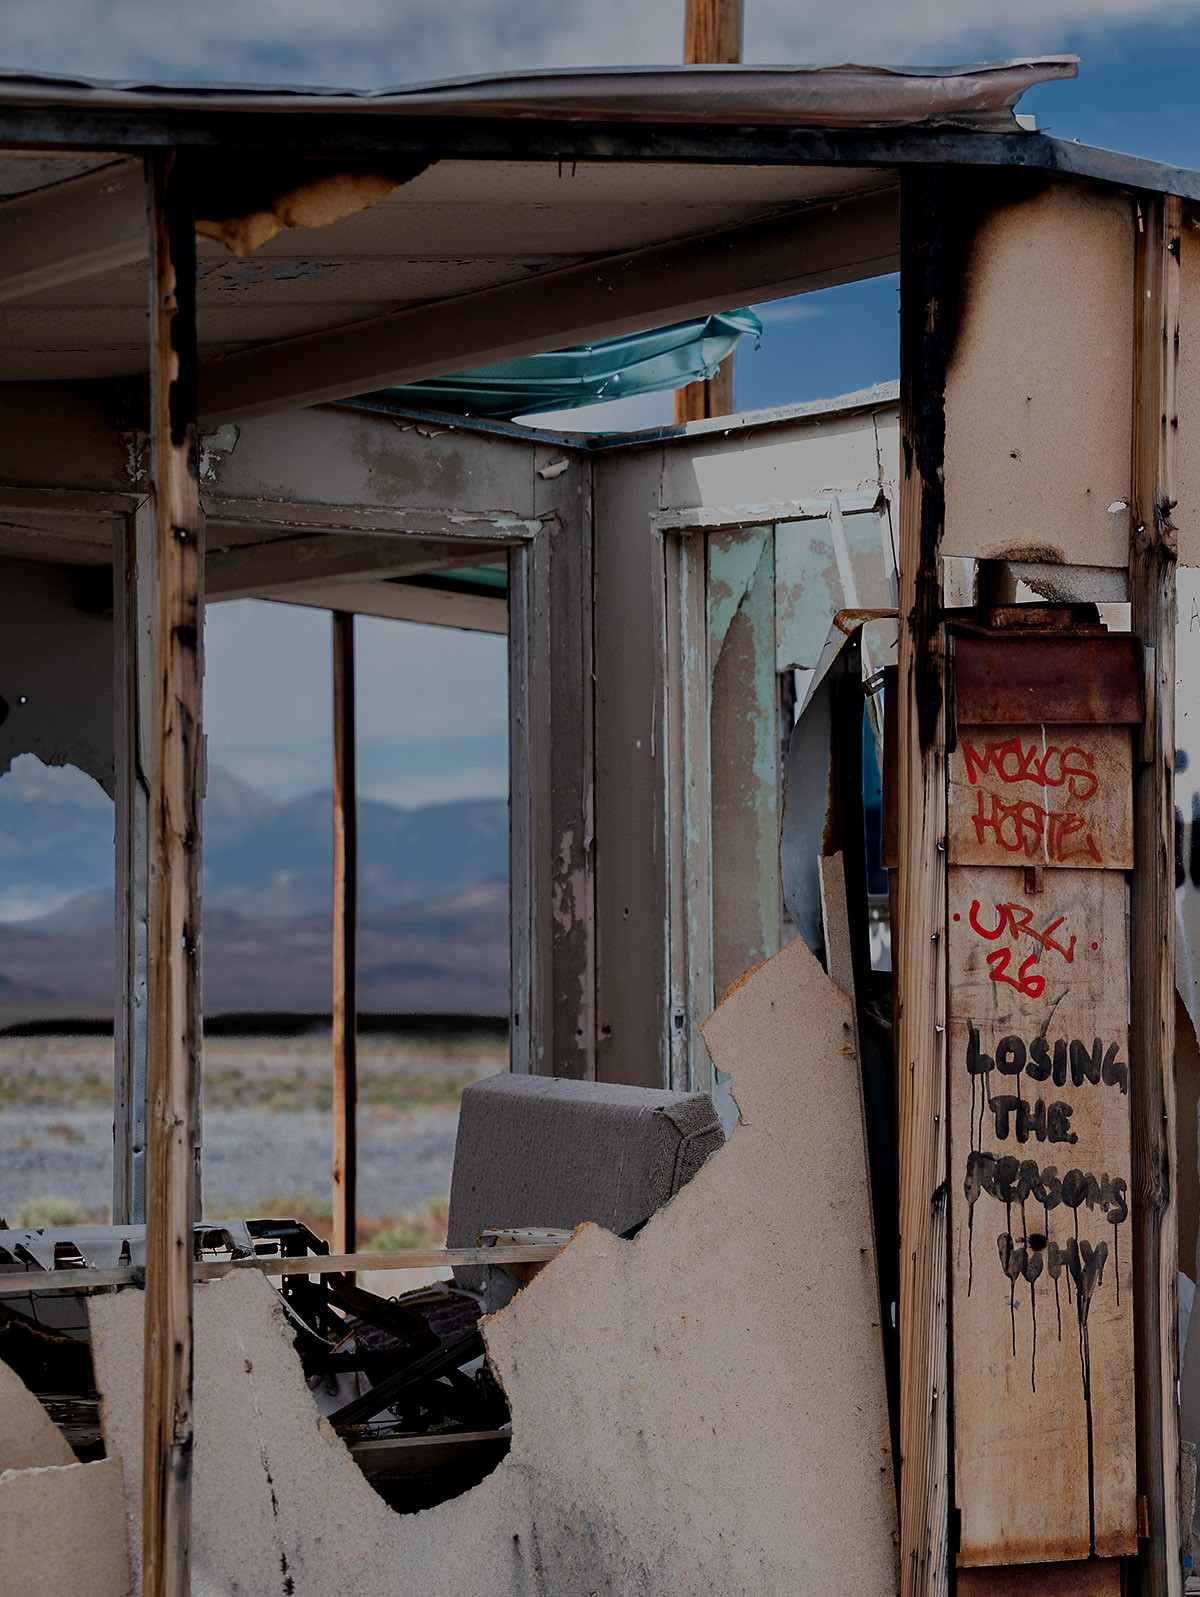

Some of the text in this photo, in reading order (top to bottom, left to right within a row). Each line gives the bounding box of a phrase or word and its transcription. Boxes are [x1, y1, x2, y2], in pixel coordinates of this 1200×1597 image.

[986, 947, 1046, 999] 26
[966, 1018, 1128, 1094] LOSING
[989, 1095, 1078, 1144] THE
[996, 1230, 1109, 1300] WHY
